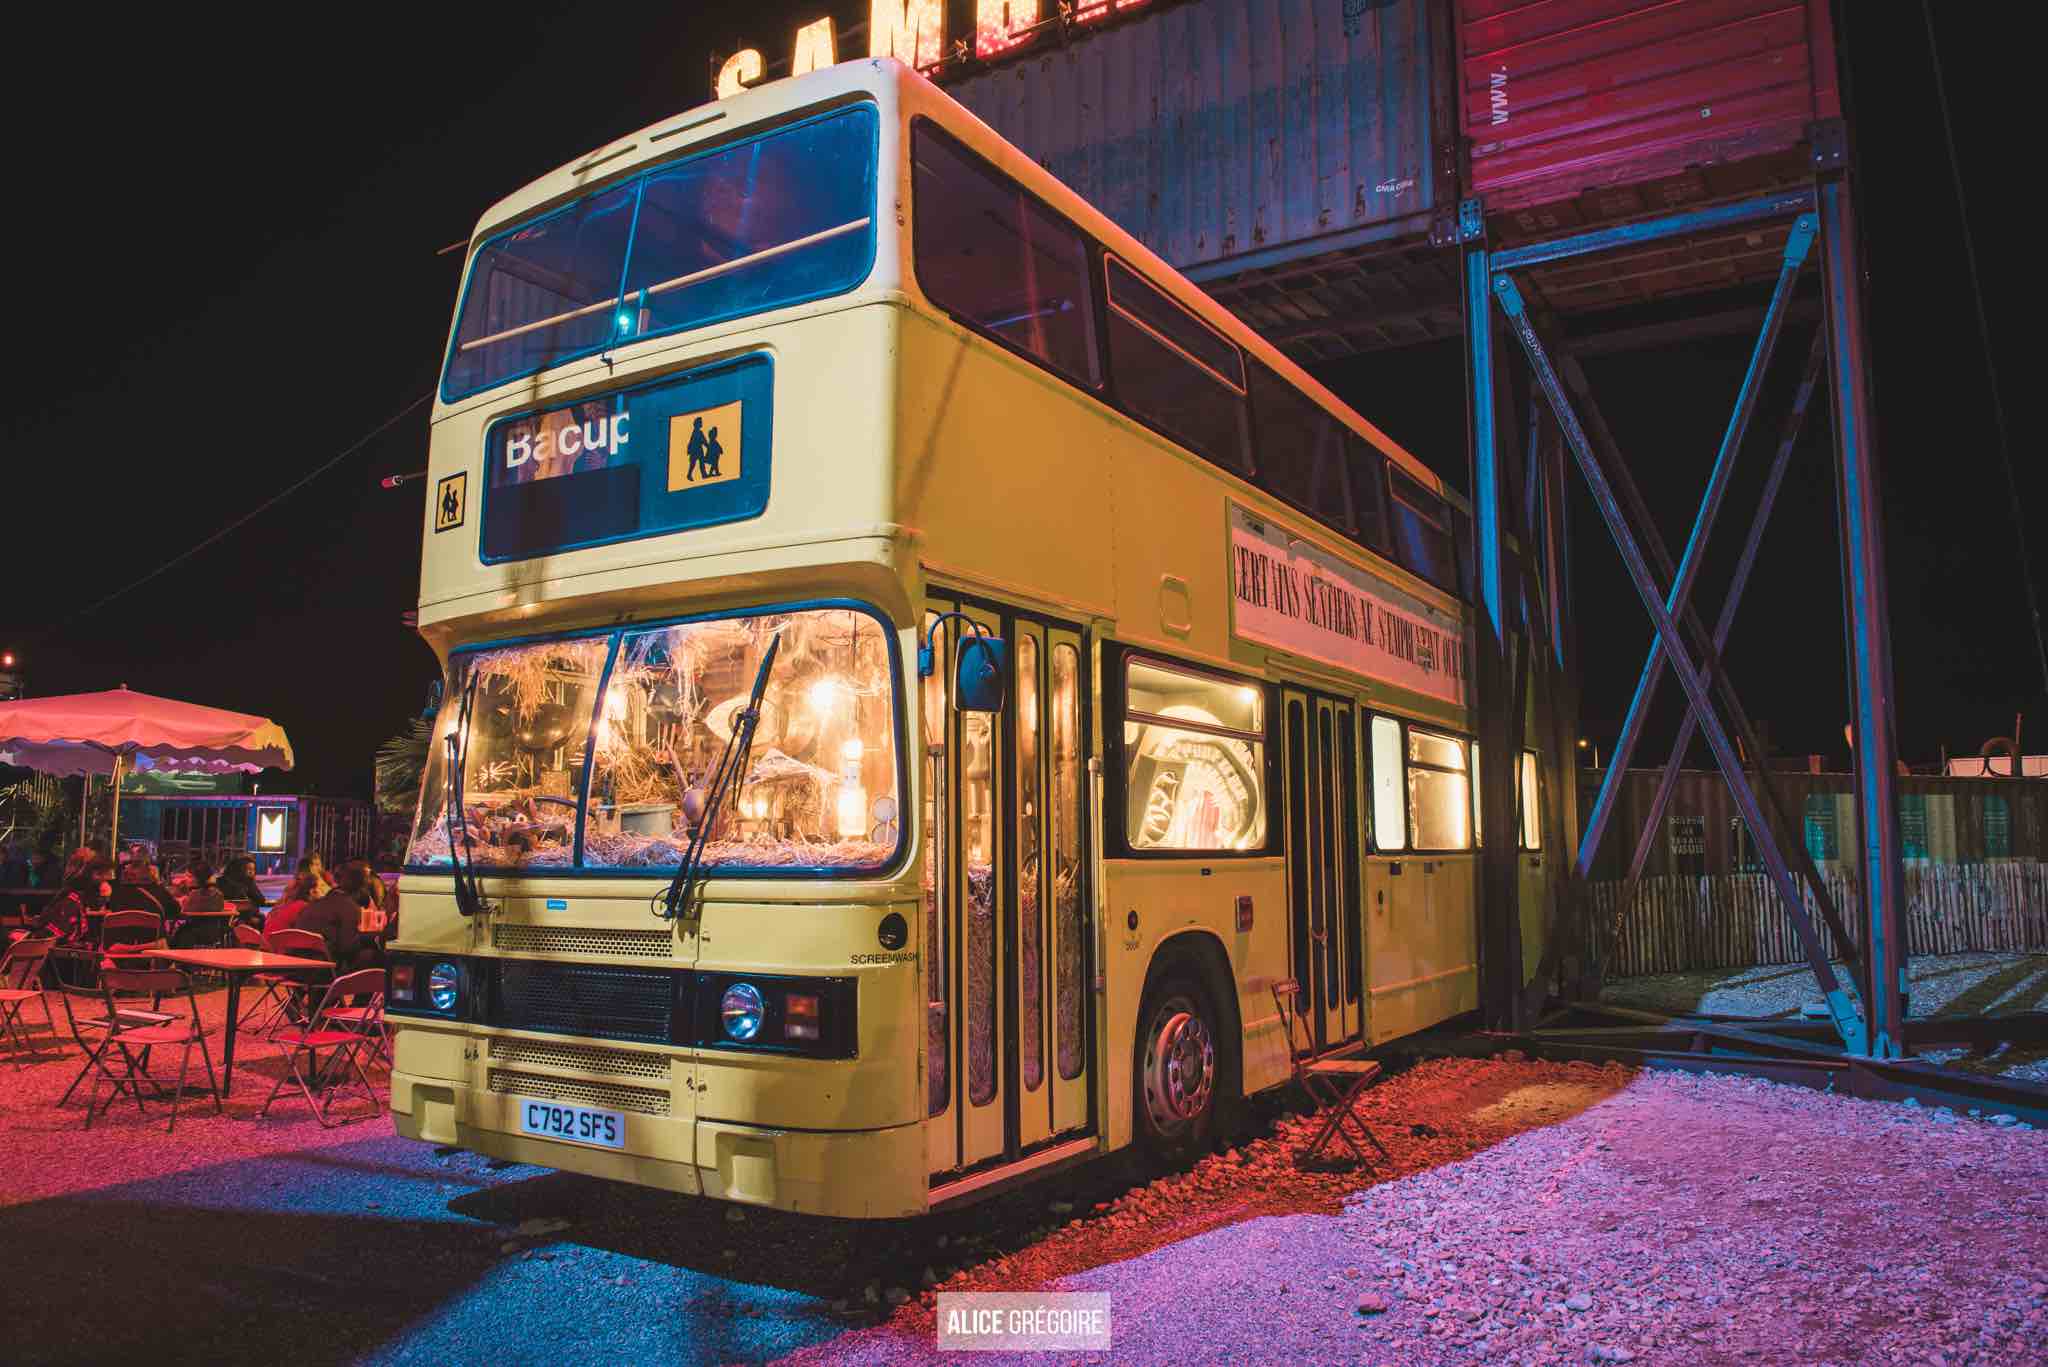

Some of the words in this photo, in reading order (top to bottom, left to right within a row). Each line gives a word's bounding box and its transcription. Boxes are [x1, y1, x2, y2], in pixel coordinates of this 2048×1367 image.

[505, 411, 630, 468] Bacup
[528, 1104, 574, 1135] C792
[580, 1111, 616, 1141] SFS
